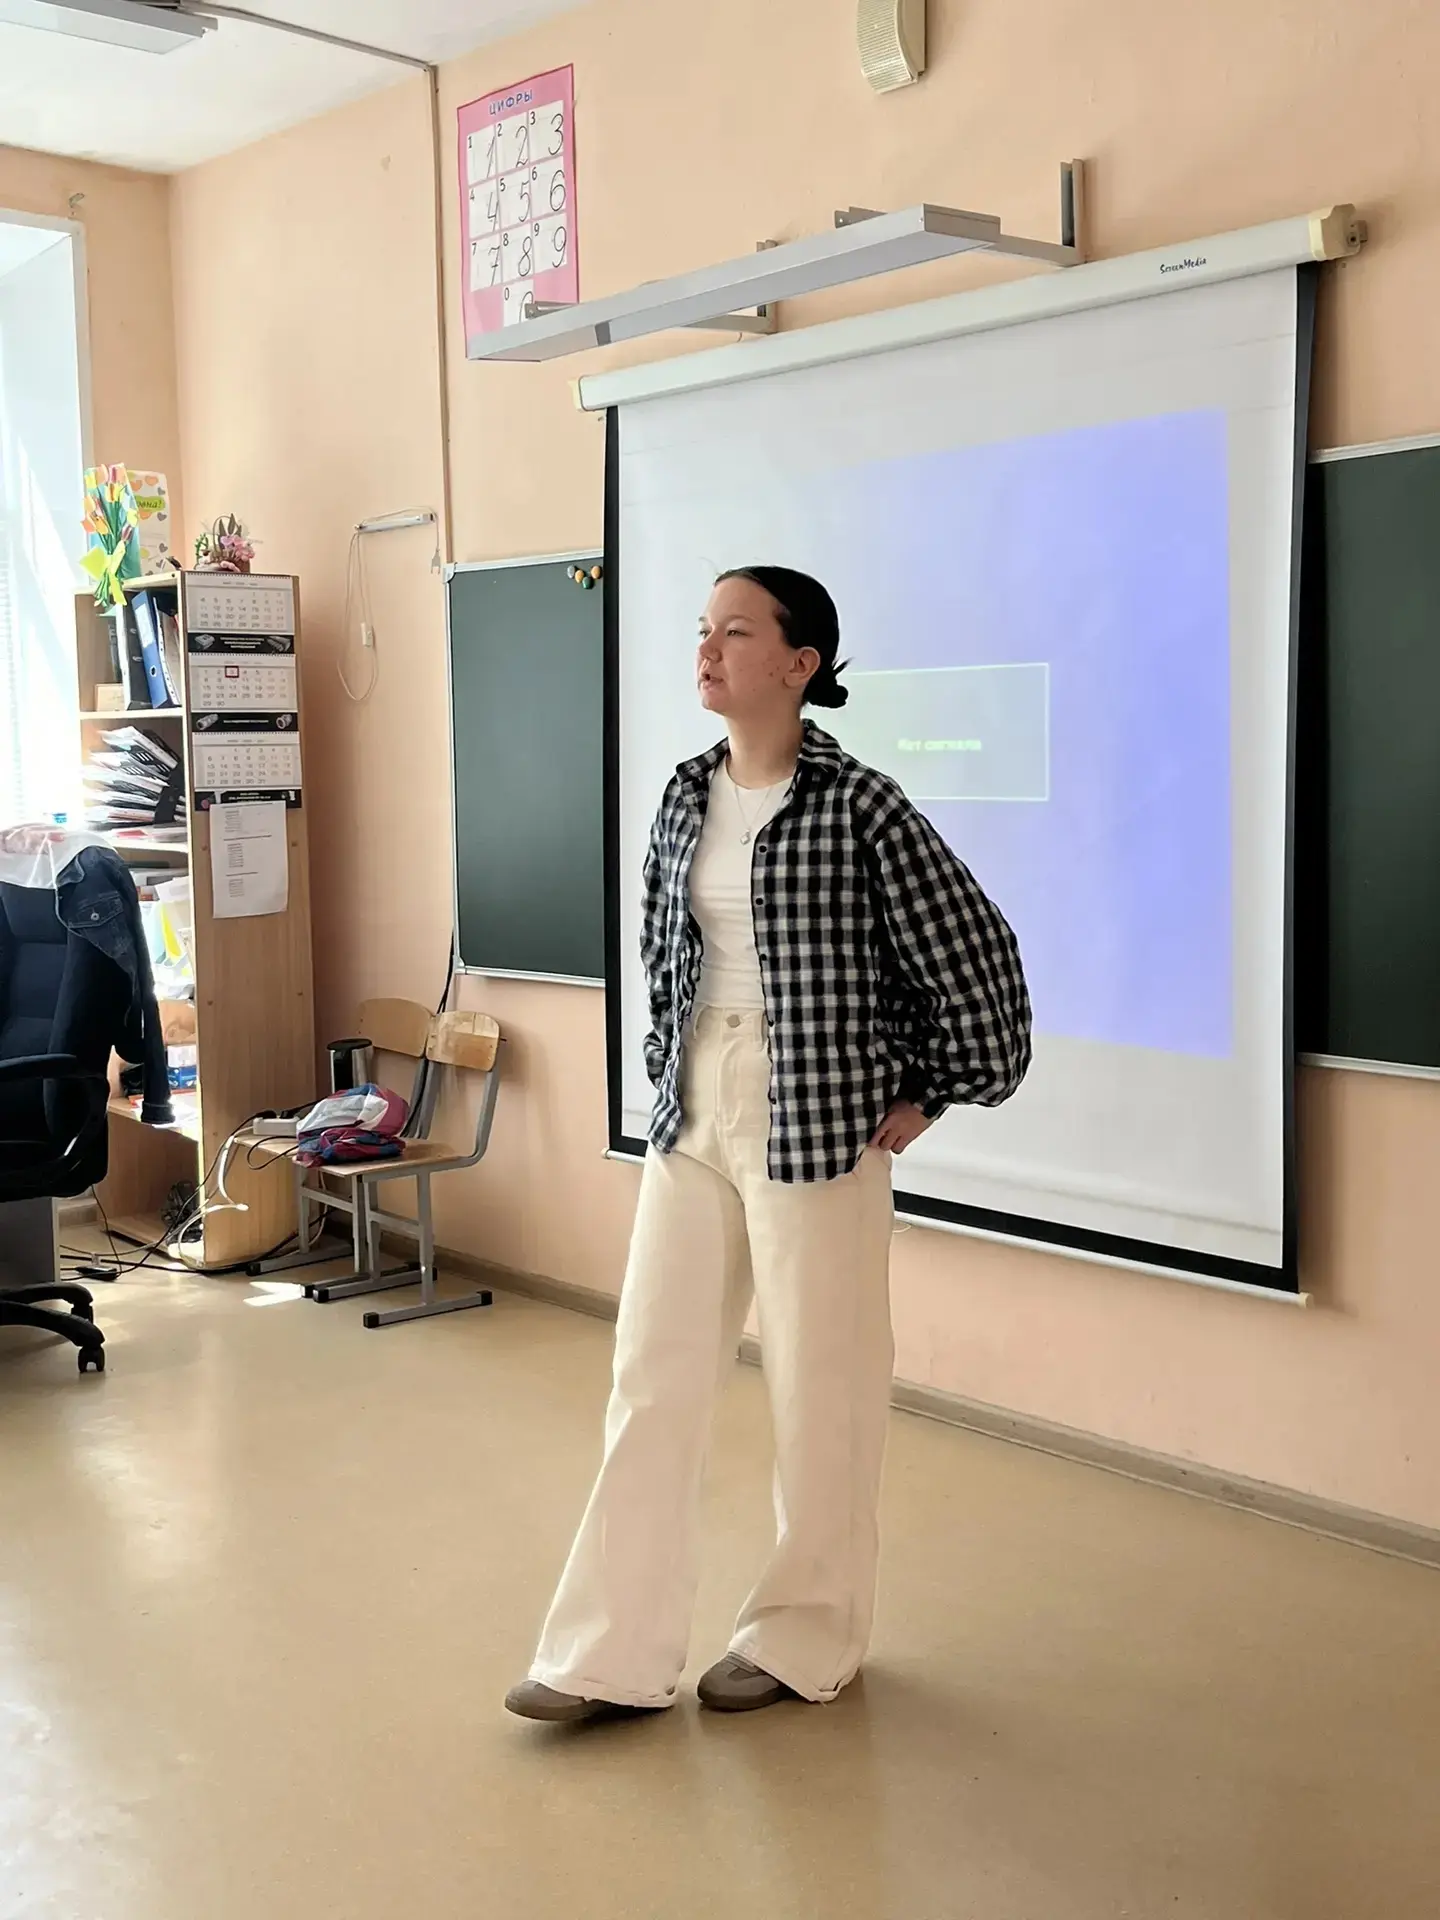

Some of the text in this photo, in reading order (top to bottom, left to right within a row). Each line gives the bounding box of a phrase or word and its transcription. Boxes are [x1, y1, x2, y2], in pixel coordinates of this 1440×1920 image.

[489, 89, 533, 115] ЦИФРЫ
[468, 112, 536, 148] 1 2 3
[487, 113, 564, 178] 1 2 3
[470, 168, 537, 201] 4 5 6
[487, 170, 566, 232] 4 5 6
[472, 223, 540, 256] 7 8 9
[488, 226, 567, 286] 7 8 9
[504, 287, 510, 300] 0
